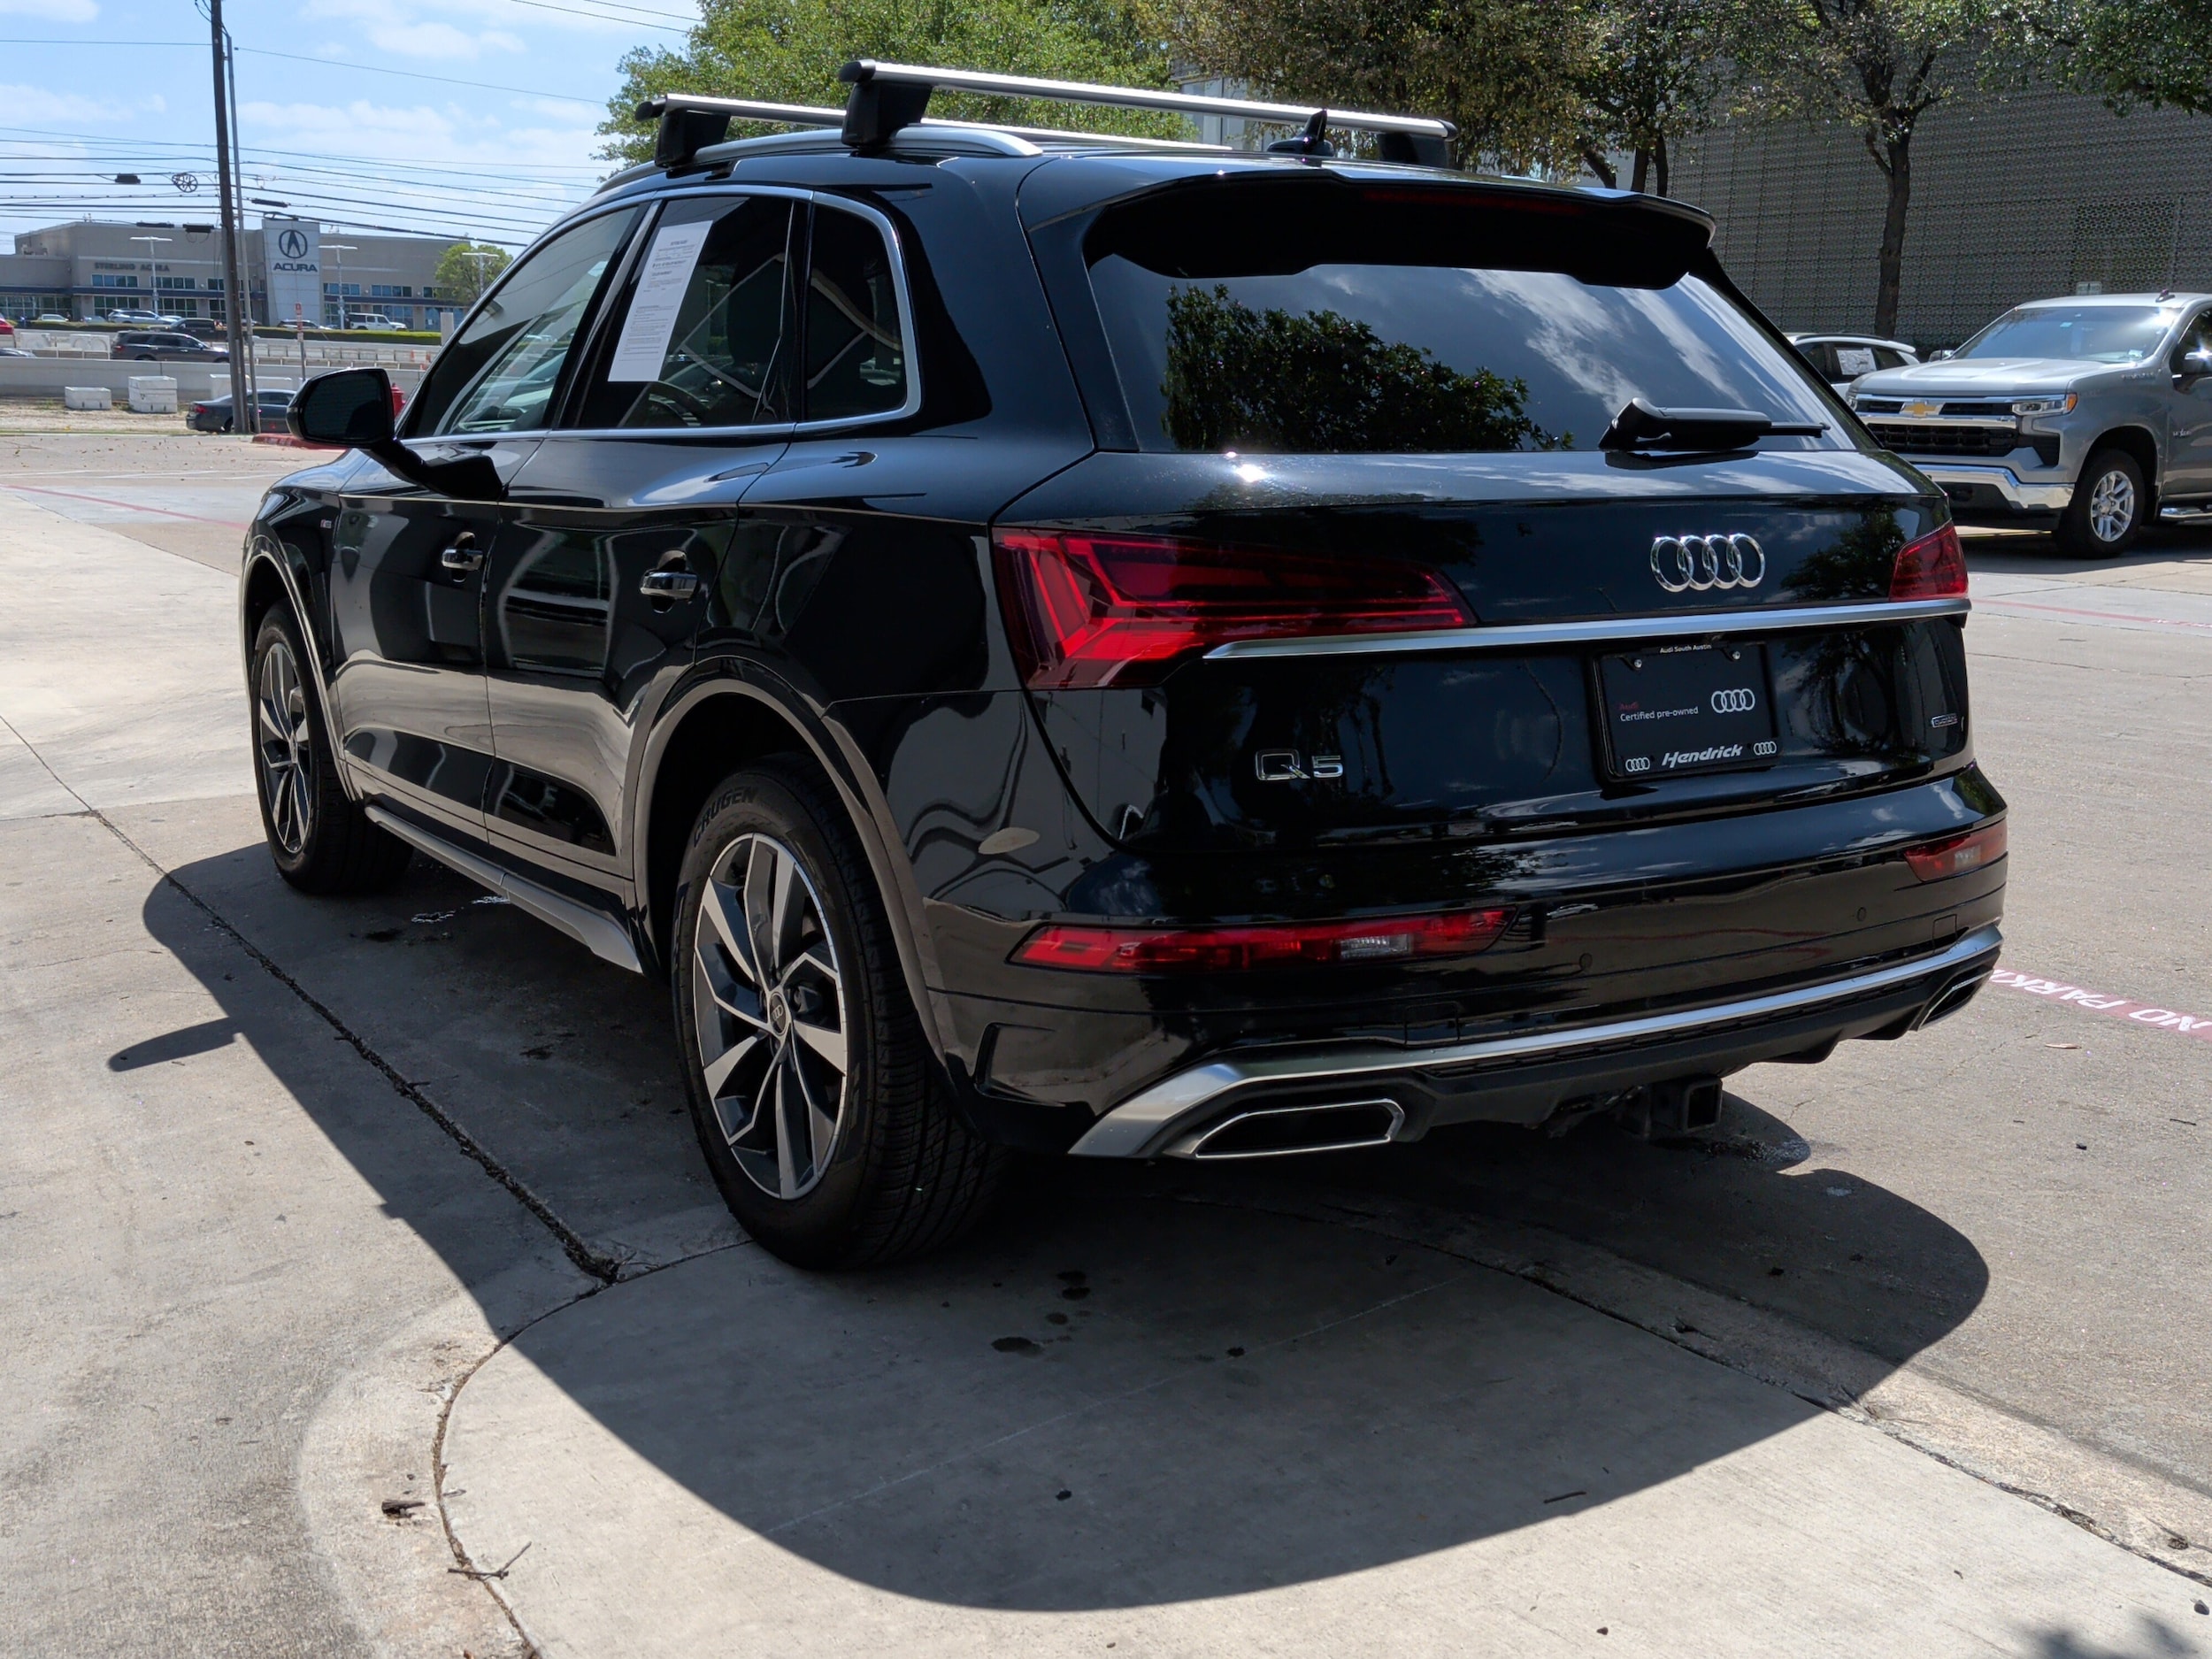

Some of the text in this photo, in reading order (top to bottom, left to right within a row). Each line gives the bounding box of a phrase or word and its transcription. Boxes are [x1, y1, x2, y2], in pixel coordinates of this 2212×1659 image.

[273, 262, 318, 273] ACURA
[1619, 701, 1639, 710] Audi
[1620, 706, 1699, 722] Certified pre-owned
[1662, 743, 1743, 769] Hendrick
[693, 786, 758, 848] CRUGEN
[1989, 968, 2212, 1031] NO PARKI
